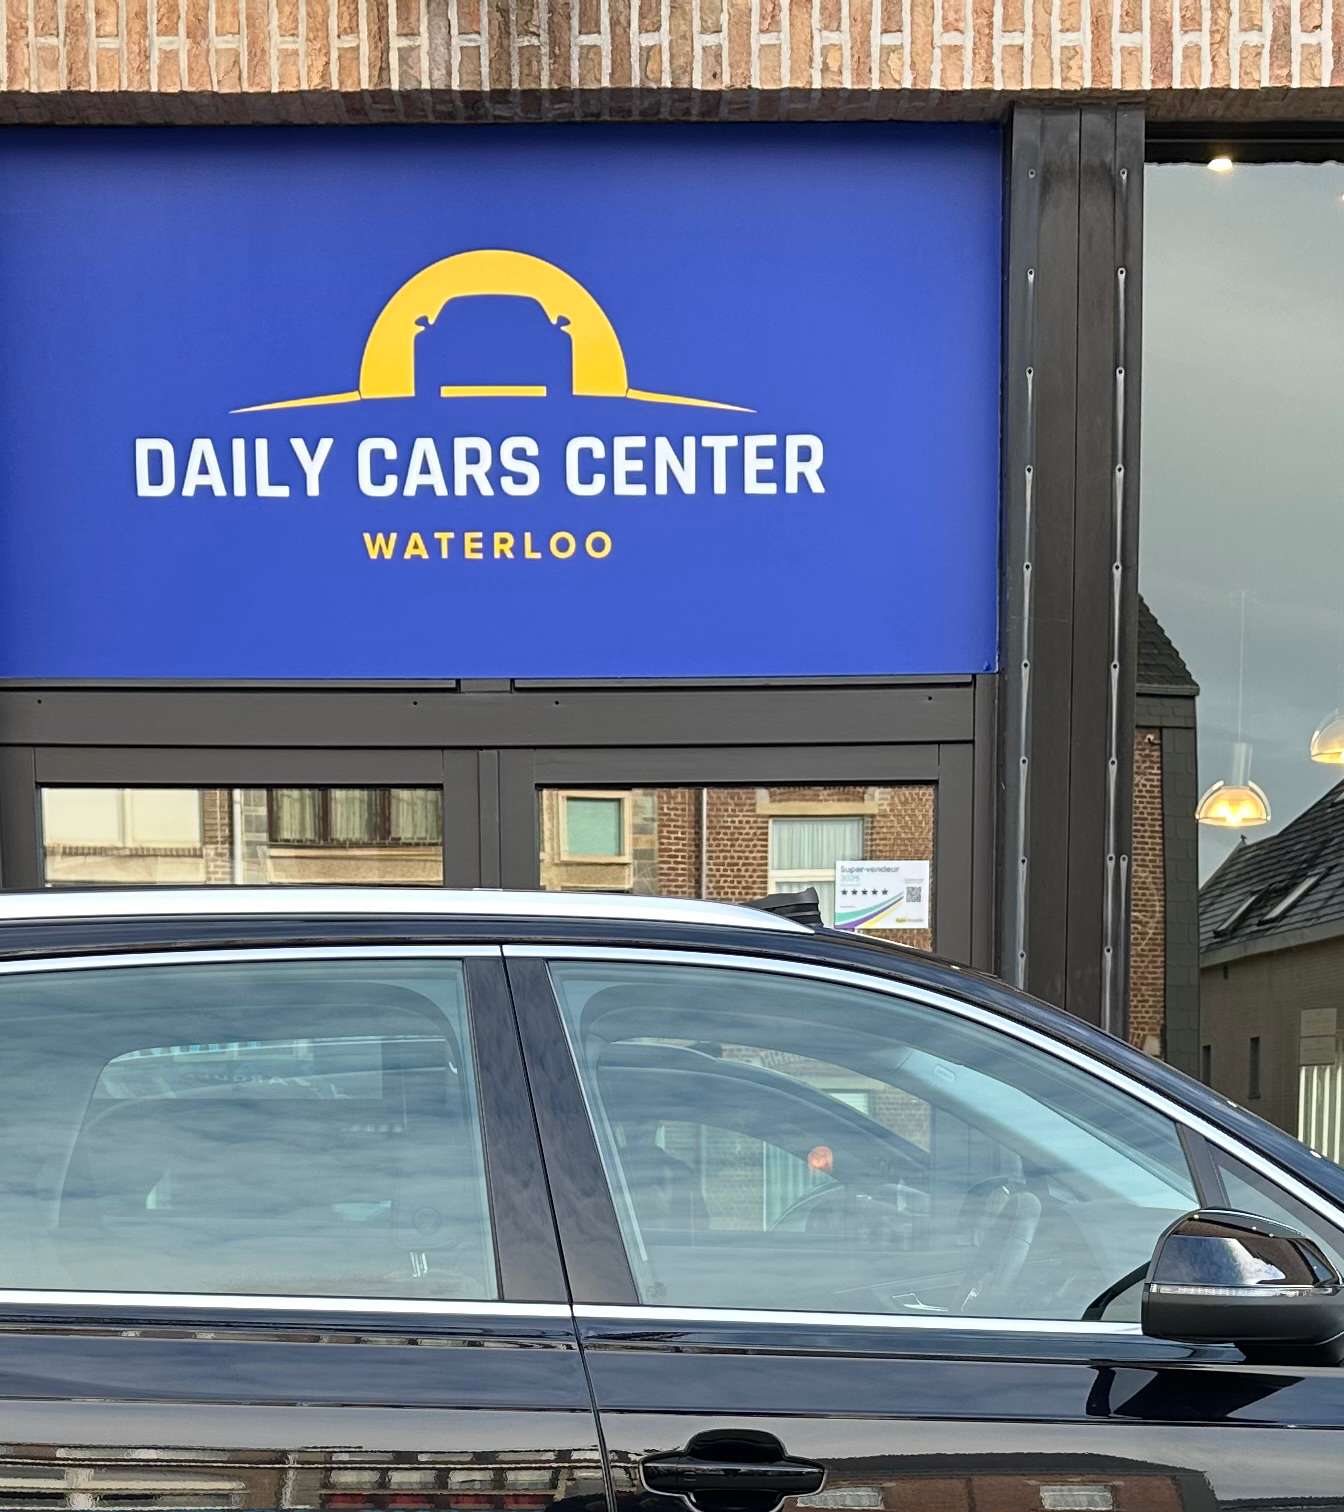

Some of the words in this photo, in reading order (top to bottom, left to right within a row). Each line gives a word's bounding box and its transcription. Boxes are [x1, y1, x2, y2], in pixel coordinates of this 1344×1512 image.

[135, 437, 334, 498] DAILY
[357, 436, 540, 498] CARS
[565, 434, 826, 497] CENTER
[363, 530, 610, 560] WATERLOO
